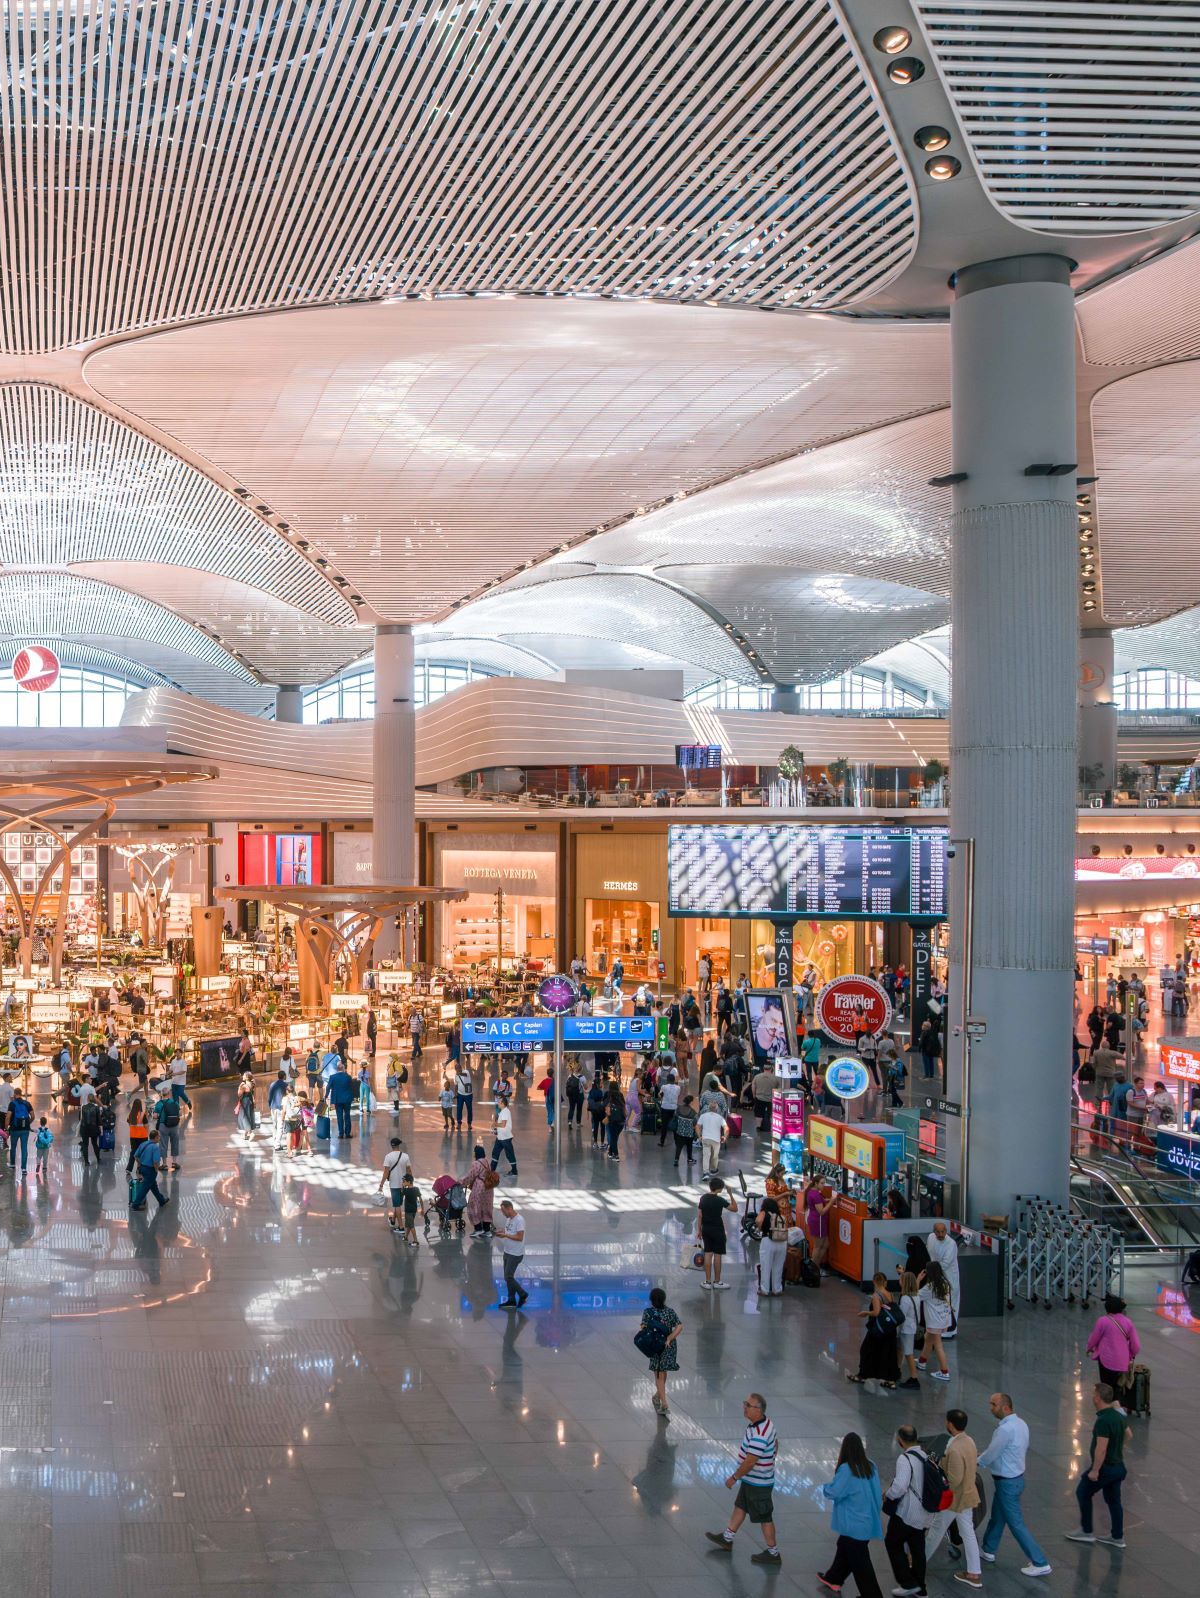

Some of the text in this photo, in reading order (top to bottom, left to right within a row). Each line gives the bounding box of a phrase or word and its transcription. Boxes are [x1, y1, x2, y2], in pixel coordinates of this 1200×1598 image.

[464, 867, 538, 879] BOTTEGA VENETA
[604, 881, 638, 891] HERMÈS
[778, 946, 789, 959] A
[917, 950, 929, 962] D
[778, 963, 787, 975] B
[917, 968, 925, 980] E
[916, 985, 924, 998] F
[833, 993, 875, 1009] Traveler
[489, 1022, 522, 1034] A B C
[596, 1022, 626, 1033] D E F
[940, 1102, 957, 1113] EF Gates
